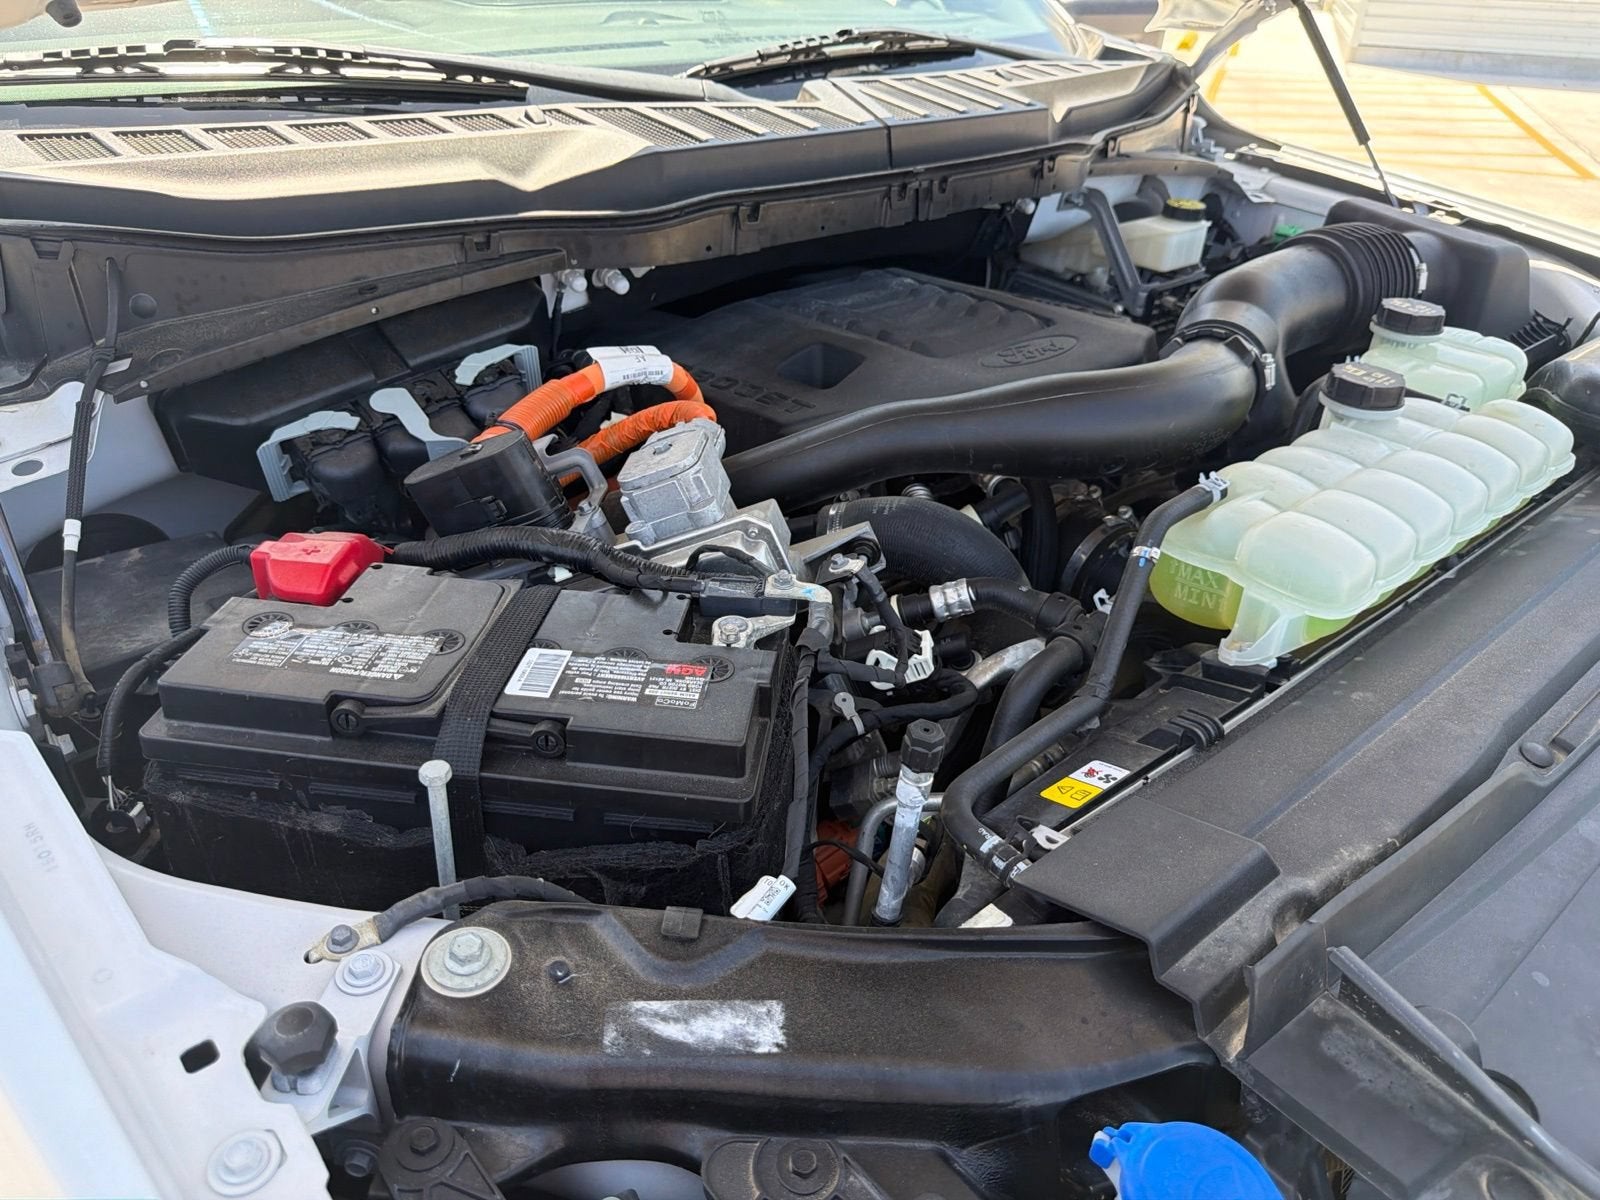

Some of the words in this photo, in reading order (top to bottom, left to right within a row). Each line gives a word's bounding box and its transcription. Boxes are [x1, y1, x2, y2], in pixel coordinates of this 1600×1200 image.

[997, 339, 1065, 365] Ford
[1177, 562, 1219, 589] MAX
[1174, 583, 1217, 609] MIN
[666, 666, 707, 676] AGM
[656, 697, 698, 710] FoMoCo
